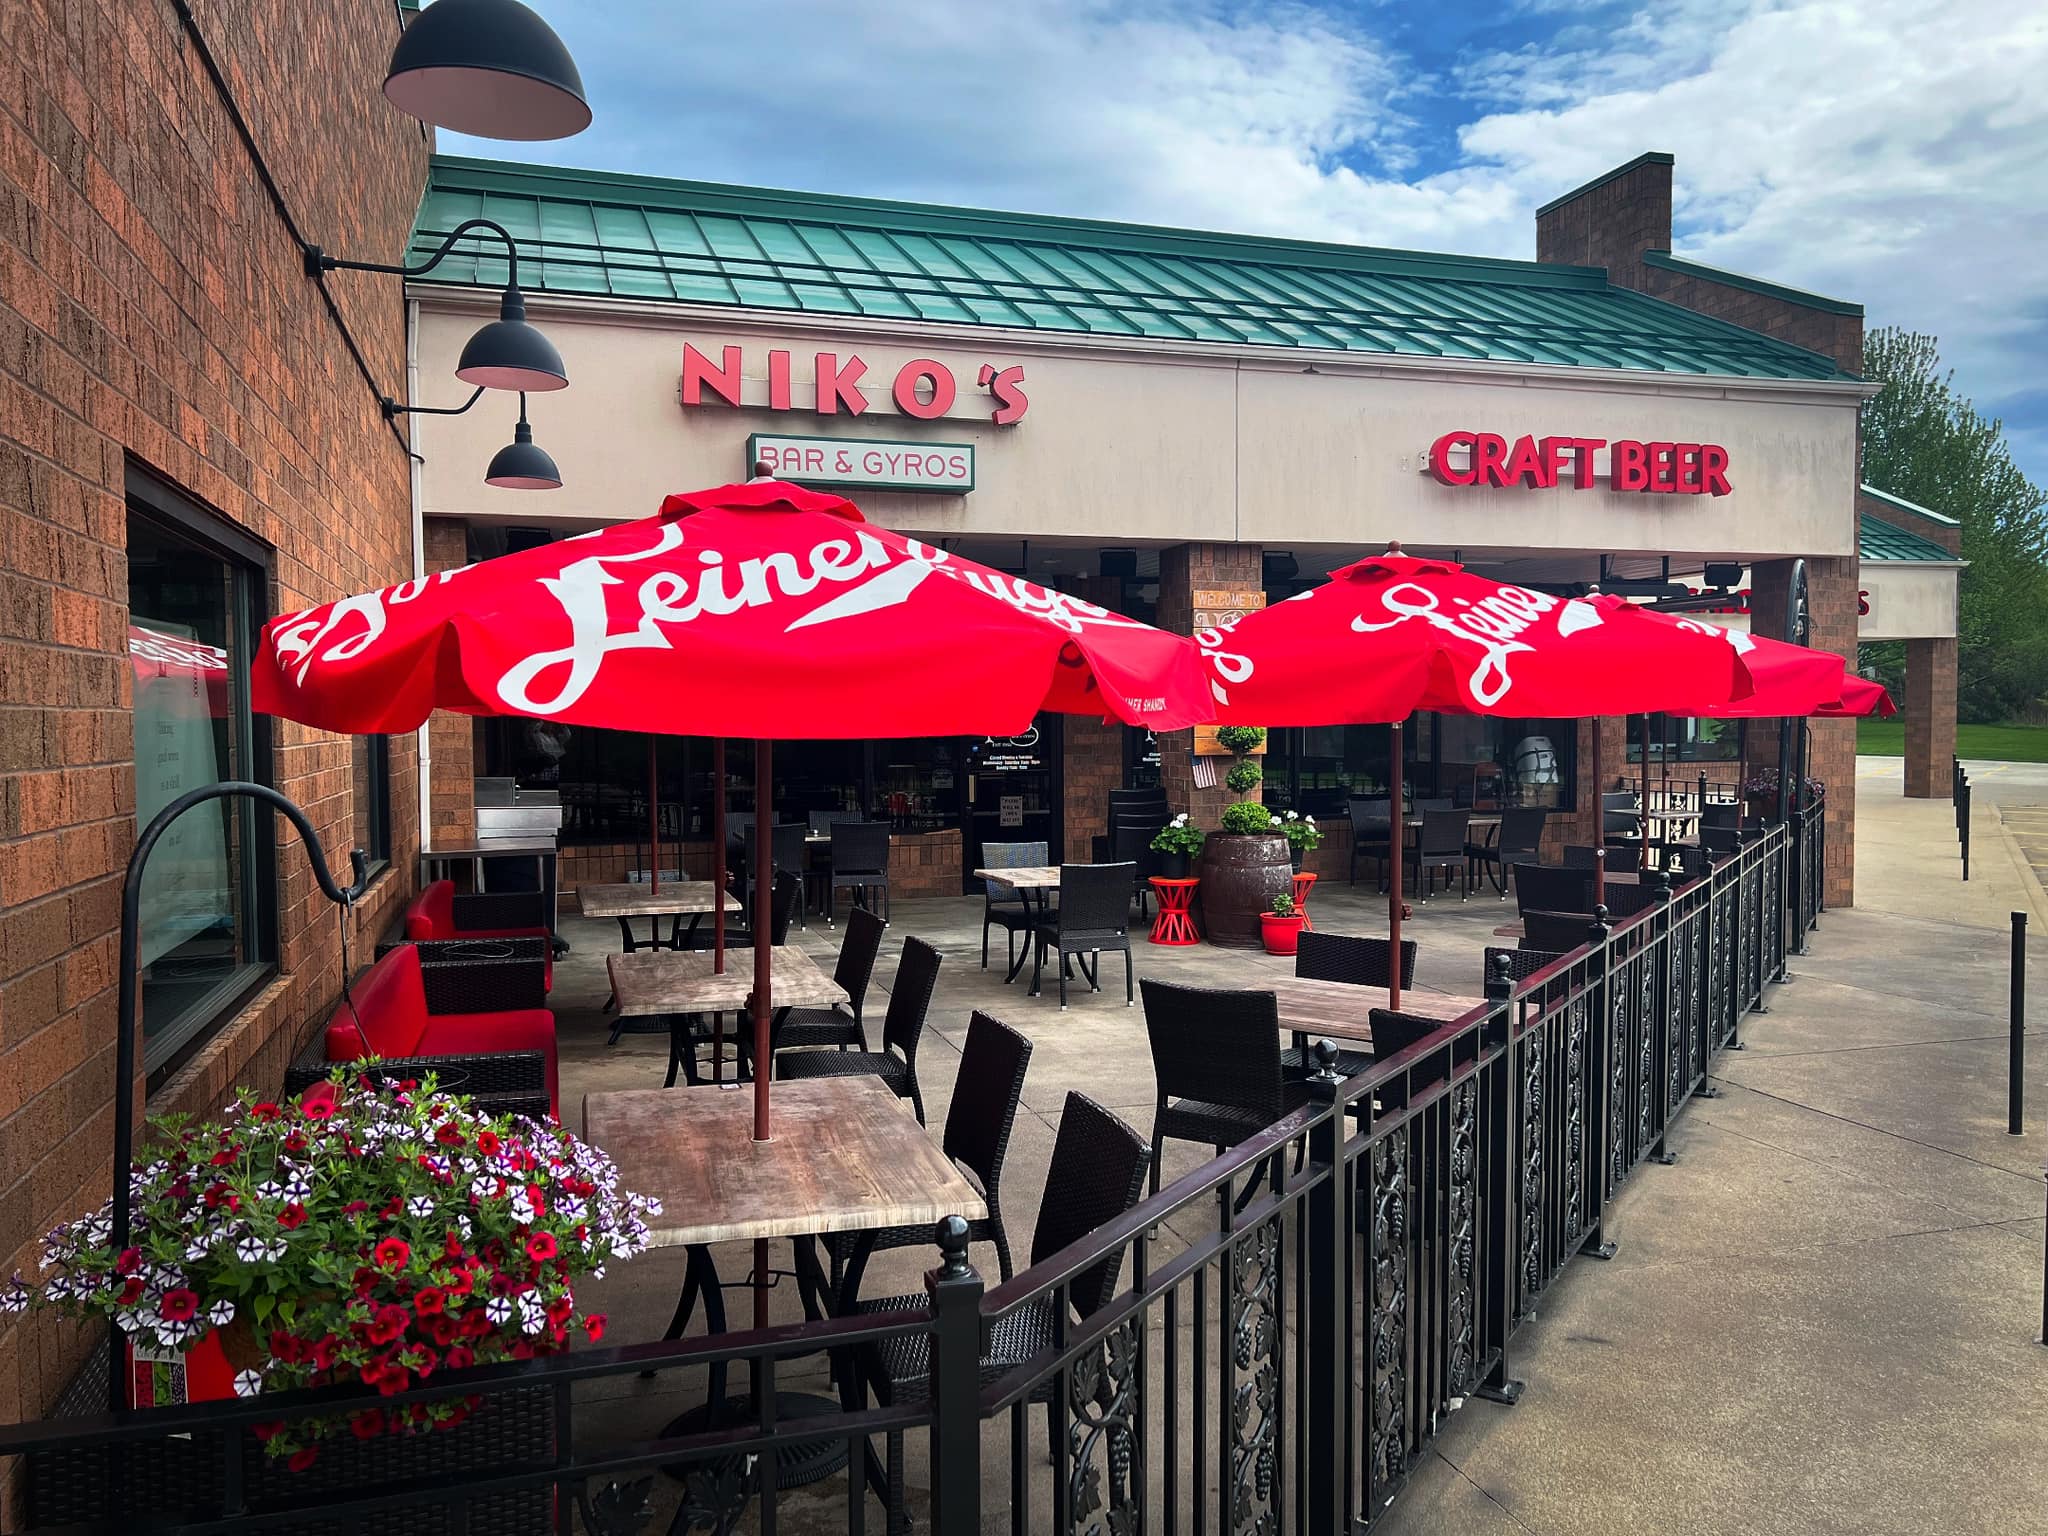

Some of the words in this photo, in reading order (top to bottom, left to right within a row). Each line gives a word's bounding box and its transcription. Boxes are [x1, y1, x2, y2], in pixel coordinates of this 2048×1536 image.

[682, 342, 1029, 425] NIKO'S
[760, 446, 825, 473] BAR
[835, 450, 853, 474] &
[863, 452, 967, 480] GYROS
[1429, 431, 1607, 490] CRAFT
[1611, 440, 1732, 497] BEER
[1199, 592, 1246, 607] WELCOME
[1248, 593, 1261, 607] TO
